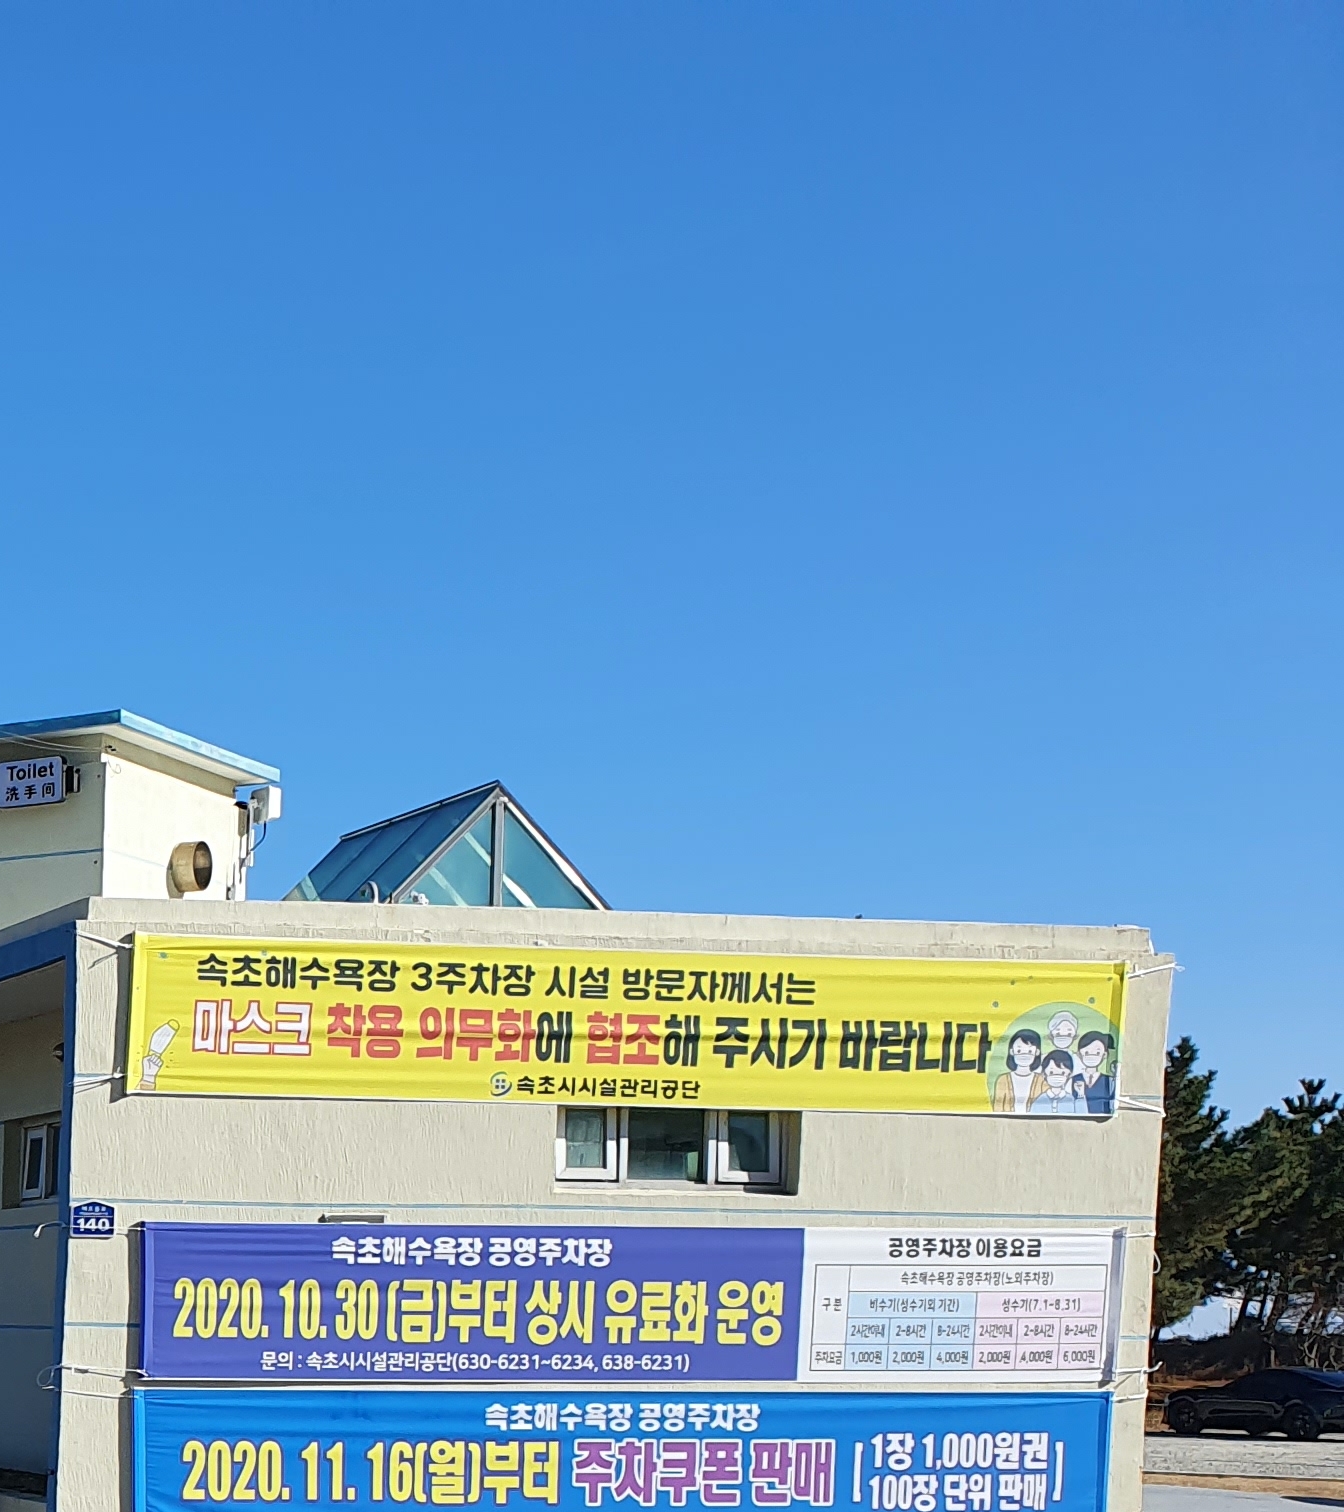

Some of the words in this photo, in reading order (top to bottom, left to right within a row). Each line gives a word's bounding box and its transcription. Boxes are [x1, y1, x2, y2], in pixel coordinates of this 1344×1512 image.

[6, 761, 55, 782] Toilet
[5, 781, 56, 802] 洗手间
[196, 953, 401, 993] 속초해수욕장
[411, 961, 536, 996] 3주차장
[544, 965, 610, 1000] 시설
[622, 968, 816, 1006] 방문자께서는
[192, 998, 313, 1056] 마스크
[327, 1003, 404, 1059] 착용
[415, 1006, 573, 1064] 의무화에
[586, 1011, 701, 1068] 협조해
[712, 1015, 827, 1071] 주시기
[838, 1020, 993, 1074] 바랍니다
[516, 1075, 702, 1100] 속초시시설관리공단
[76, 1218, 110, 1232] 140
[331, 1236, 483, 1267] 속초해수욕장
[488, 1236, 613, 1268] 공영주차장
[887, 1237, 972, 1258] 공영주차장
[976, 1237, 1043, 1258] 이용요금
[900, 1271, 955, 1286] 속초해수욕장
[172, 1277, 269, 1340] 2020.
[278, 1278, 328, 1340] 10.
[525, 1279, 596, 1346] 상시
[604, 1279, 709, 1345] 유료화
[716, 1280, 785, 1347] 운영
[602, 1353, 691, 1373] 638-6231)
[814, 1350, 843, 1365] 주차요금
[850, 1350, 883, 1365] 1,000원
[892, 1350, 925, 1365] 2,000원
[978, 1350, 1011, 1365] 2,000원
[485, 1402, 634, 1432] 속초해수욕장
[638, 1402, 761, 1433] 공영주차장
[870, 1431, 915, 1472] 1장
[921, 1431, 1049, 1471] 1,000원권
[181, 1439, 290, 1502] 2020.
[300, 1440, 356, 1501] 11.
[367, 1439, 560, 1505] 16(월)부터
[572, 1437, 744, 1507] 주차쿠폰
[749, 1437, 837, 1508] 판매
[868, 1473, 939, 1512] 100장
[943, 1473, 993, 1512] 단위
[998, 1473, 1048, 1511] 판매
